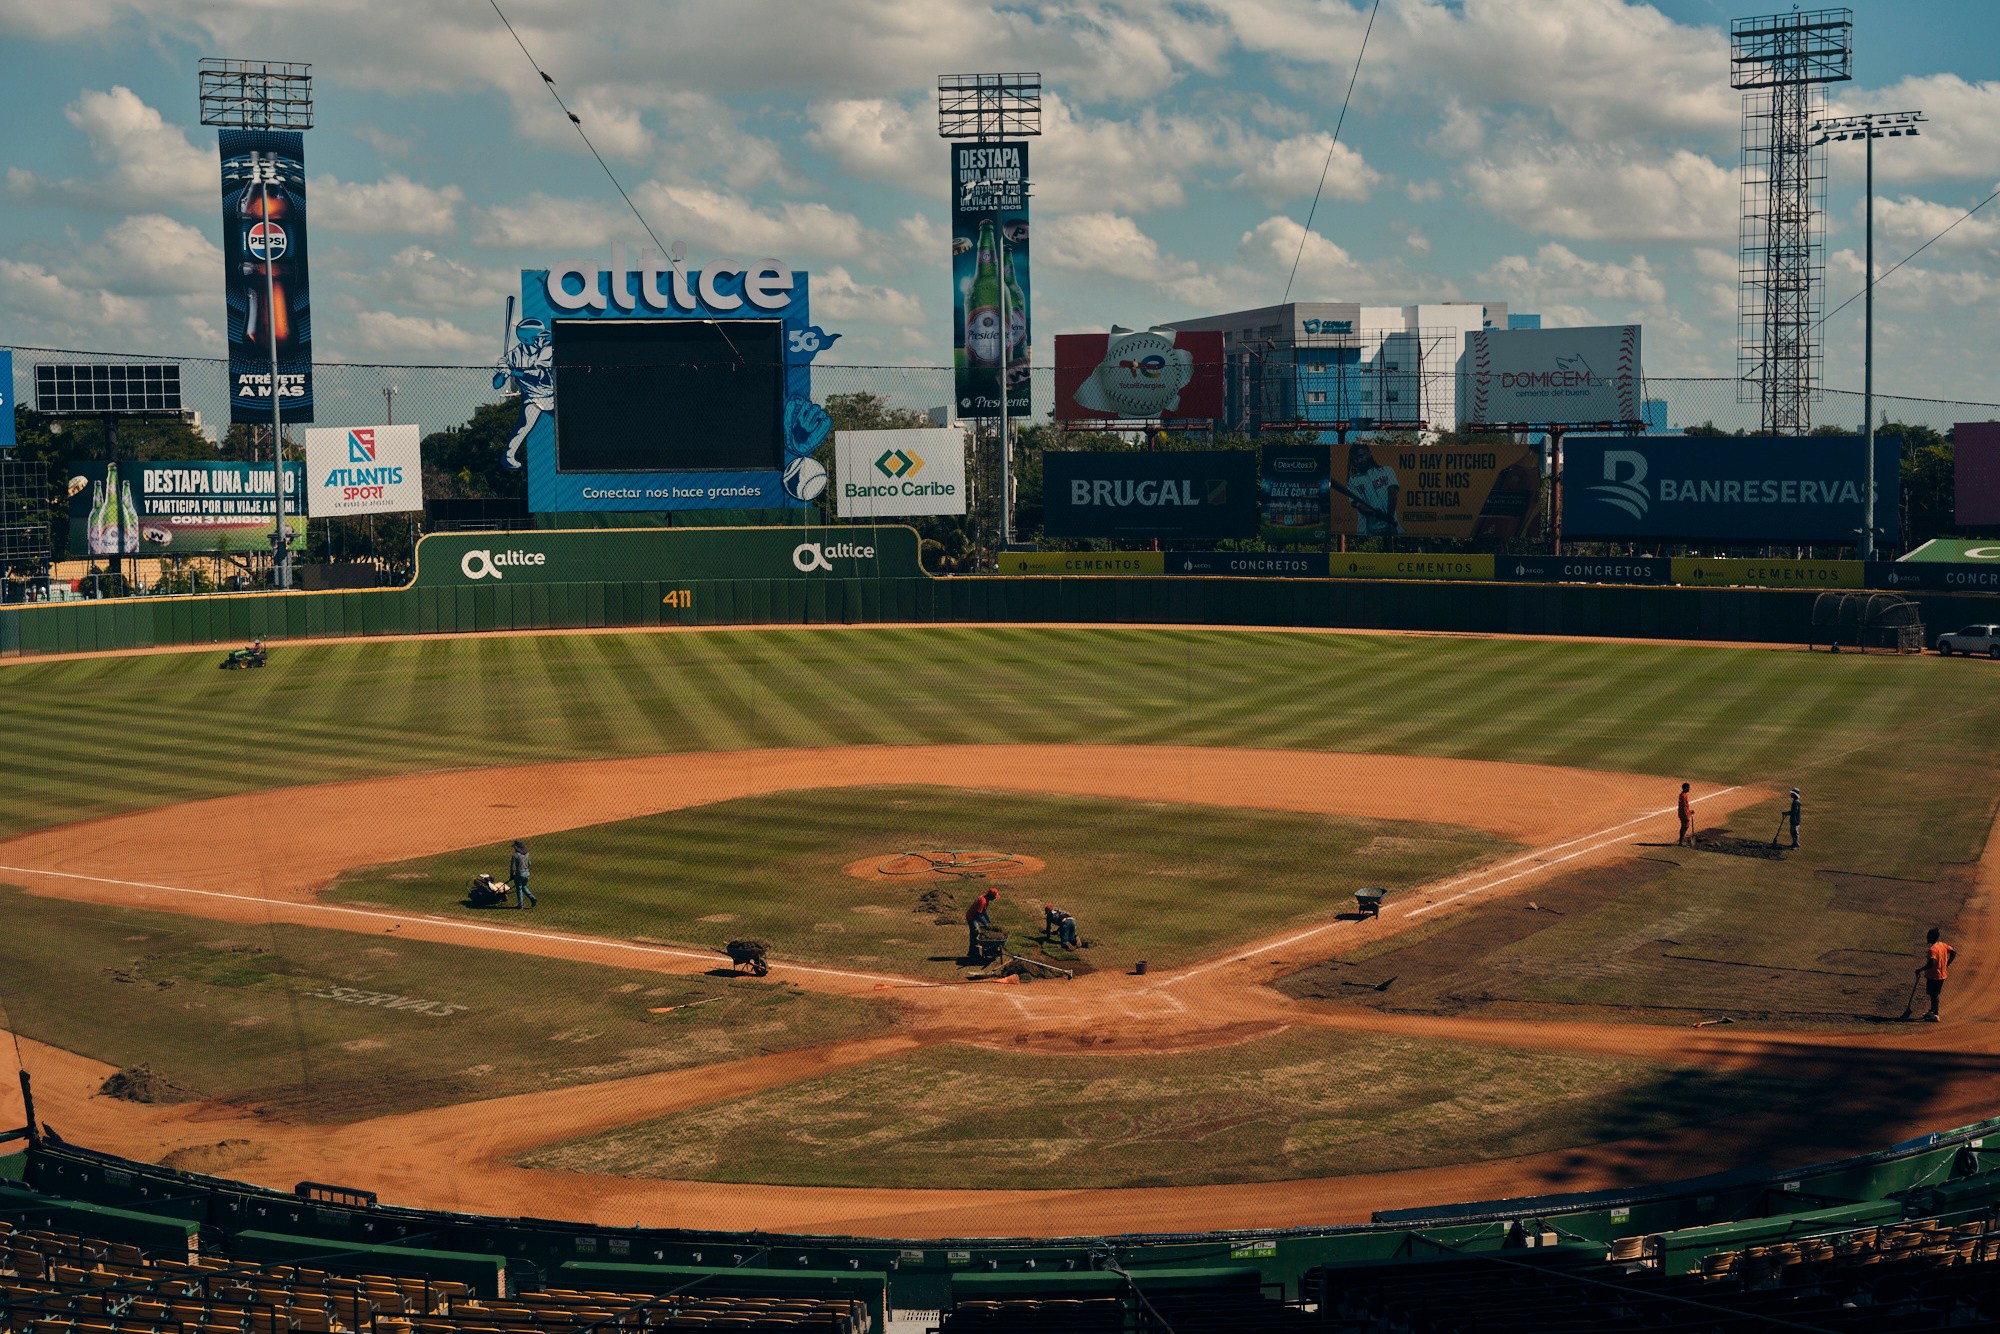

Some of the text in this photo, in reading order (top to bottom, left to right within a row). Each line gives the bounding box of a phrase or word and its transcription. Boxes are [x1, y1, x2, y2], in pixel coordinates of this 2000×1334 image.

[960, 148, 1020, 170] DESTAPA
[960, 168, 1020, 183] UNA JUMBO
[972, 196, 992, 206] VIAJE
[993, 196, 998, 205] A
[546, 241, 794, 310] altice
[788, 330, 820, 353] 5G
[1502, 371, 1590, 388] DOMICEM
[239, 384, 305, 397] A MÁS
[975, 396, 1029, 408] Presiente
[1399, 453, 1496, 469] NO HAY PITCHEO
[143, 469, 295, 494] DESTAPA UNA JUMO
[324, 467, 403, 487] ATLANTIS
[1419, 473, 1470, 489] QUE NOS
[344, 486, 384, 500] SPORT
[582, 485, 761, 500] Conectar nos hace grandes
[845, 482, 955, 497] Banco Caribe
[1071, 479, 1200, 506] BRUGAL
[1407, 491, 1460, 507] DETENGA
[144, 500, 295, 514] Y PARTICIPA POR UN VIAJE A MMI
[171, 516, 203, 524] CON
[494, 550, 546, 566] altice
[824, 542, 875, 559] altice
[1066, 560, 1140, 570] CEMENTOS
[1230, 560, 1308, 570] CONCRETOS
[1398, 562, 1472, 572] CEMENTOS
[1564, 565, 1651, 577] CONCRETOS
[1748, 568, 1838, 580] CEMENTOS
[1946, 572, 1998, 584] CONCR
[662, 589, 691, 608] 411
